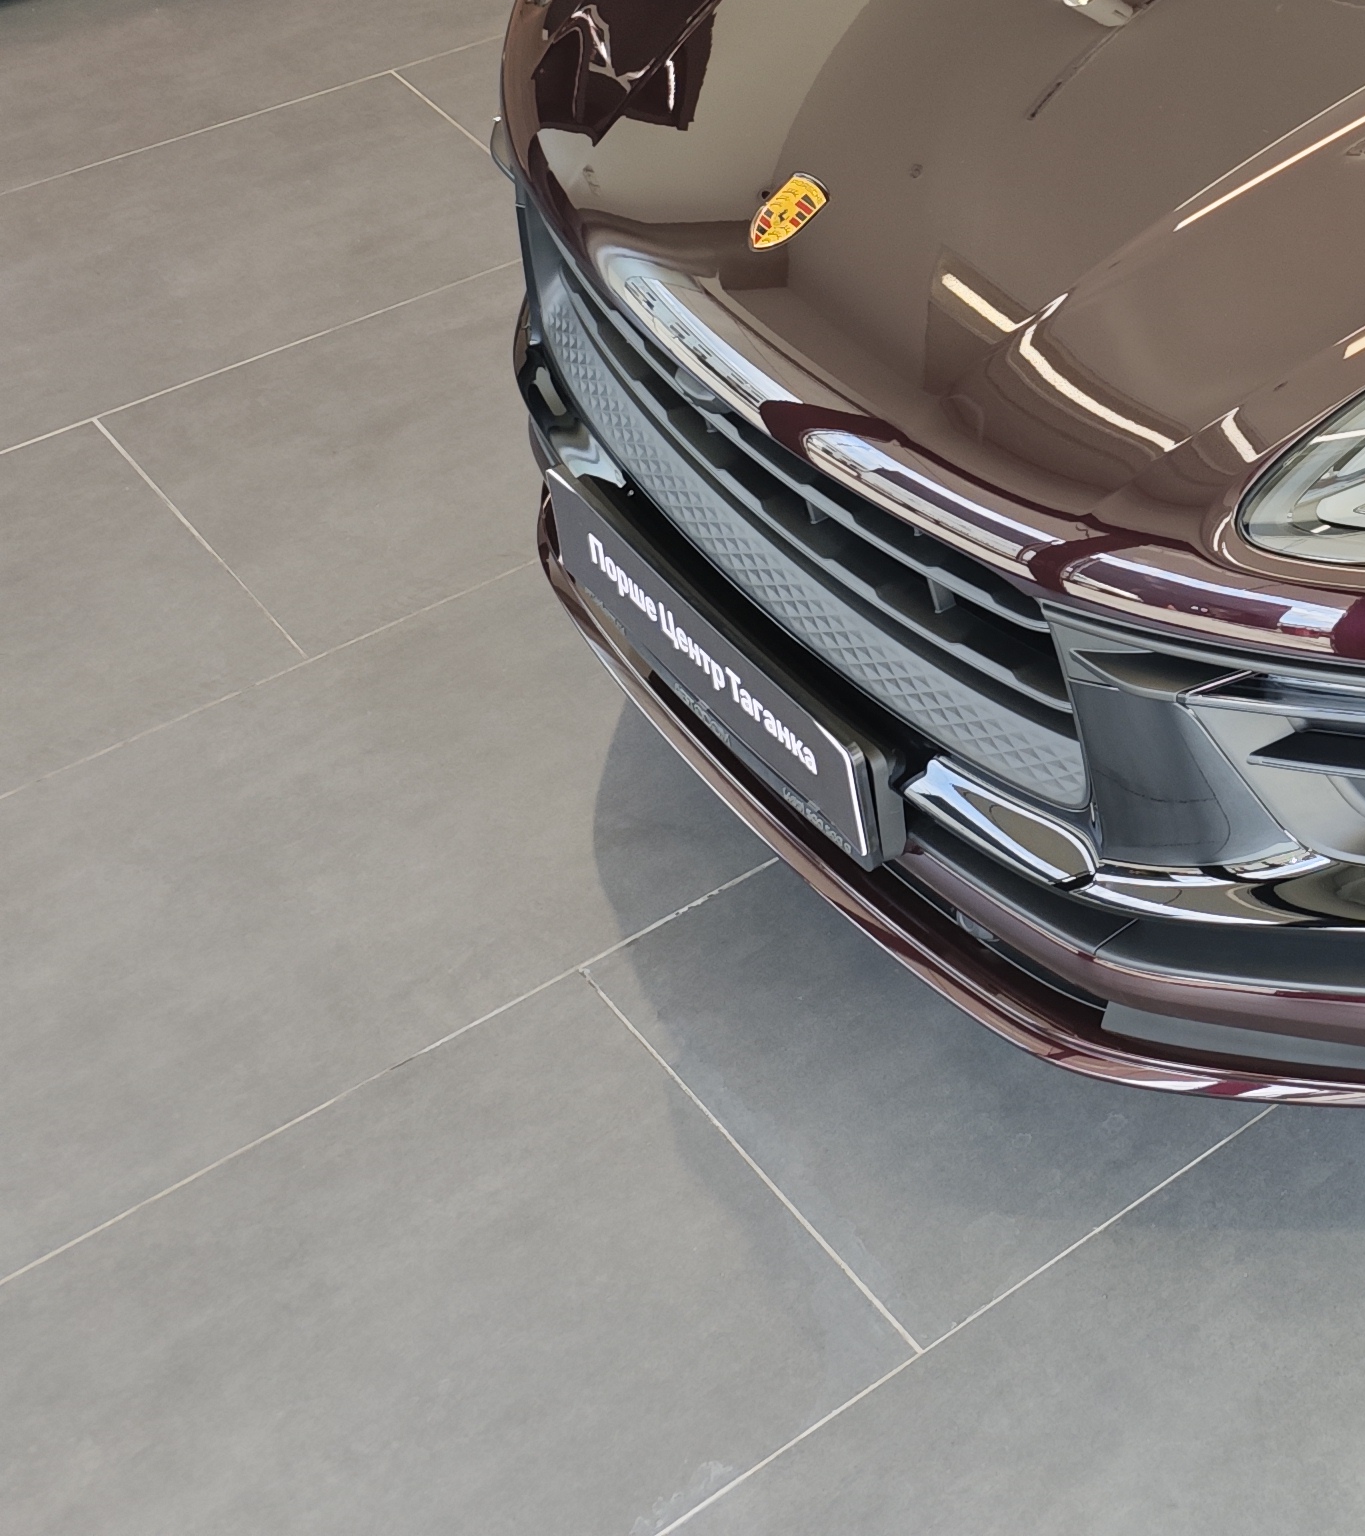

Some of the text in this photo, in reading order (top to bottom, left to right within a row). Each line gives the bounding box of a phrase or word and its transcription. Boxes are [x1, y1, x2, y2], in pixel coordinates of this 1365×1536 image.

[588, 532, 658, 623] Порше
[659, 601, 725, 691] Центр
[725, 666, 818, 776] Таганка
